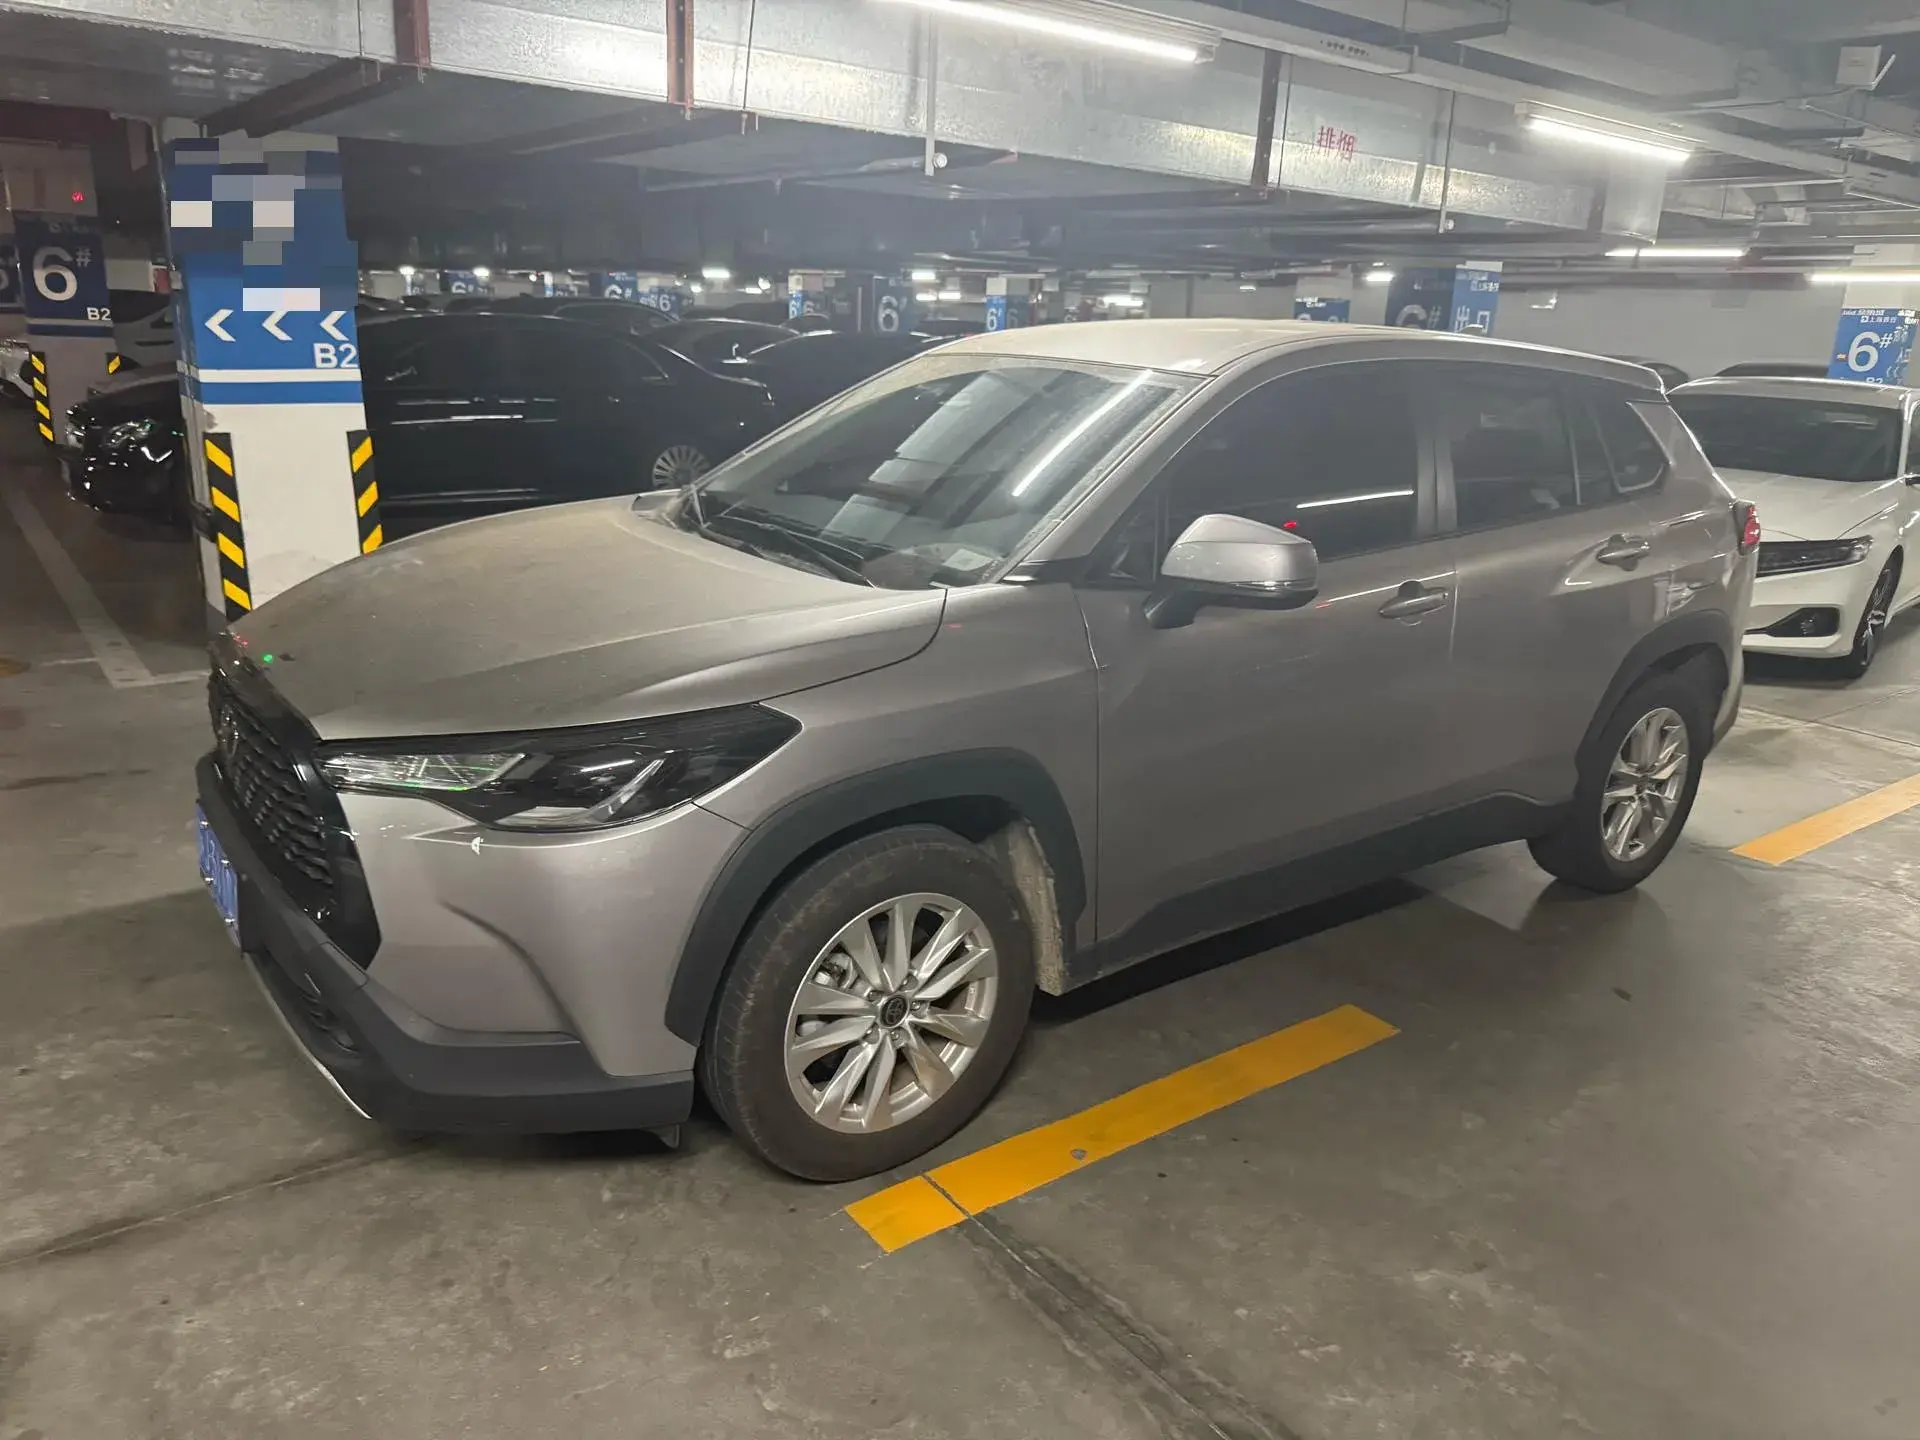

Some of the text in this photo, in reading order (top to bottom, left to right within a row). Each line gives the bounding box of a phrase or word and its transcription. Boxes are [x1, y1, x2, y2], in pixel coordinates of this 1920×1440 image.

[33, 246, 92, 301] 6#
[86, 307, 112, 321] B2
[313, 343, 359, 368] B2
[1848, 331, 1893, 373] 6#
